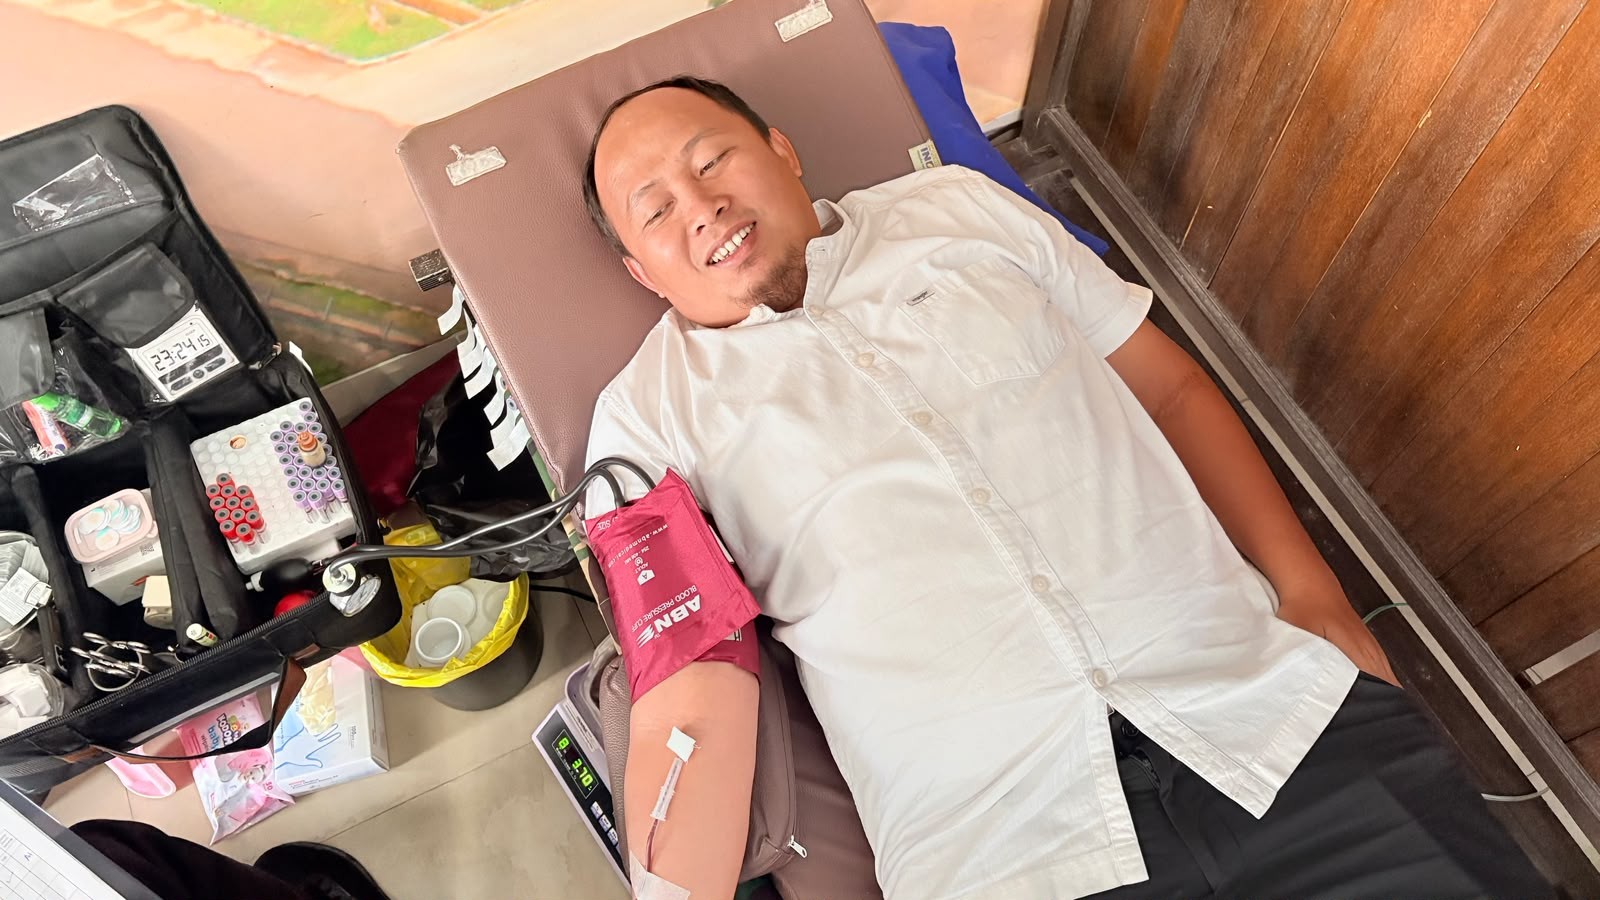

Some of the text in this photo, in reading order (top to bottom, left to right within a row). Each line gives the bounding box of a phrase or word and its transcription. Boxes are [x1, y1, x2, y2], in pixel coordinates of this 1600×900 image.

[150, 334, 211, 371] 23:24 15
[631, 585, 698, 633] BLOOD PRESSURE CUFF
[653, 594, 701, 633] ABN
[216, 712, 234, 748] KODOM
